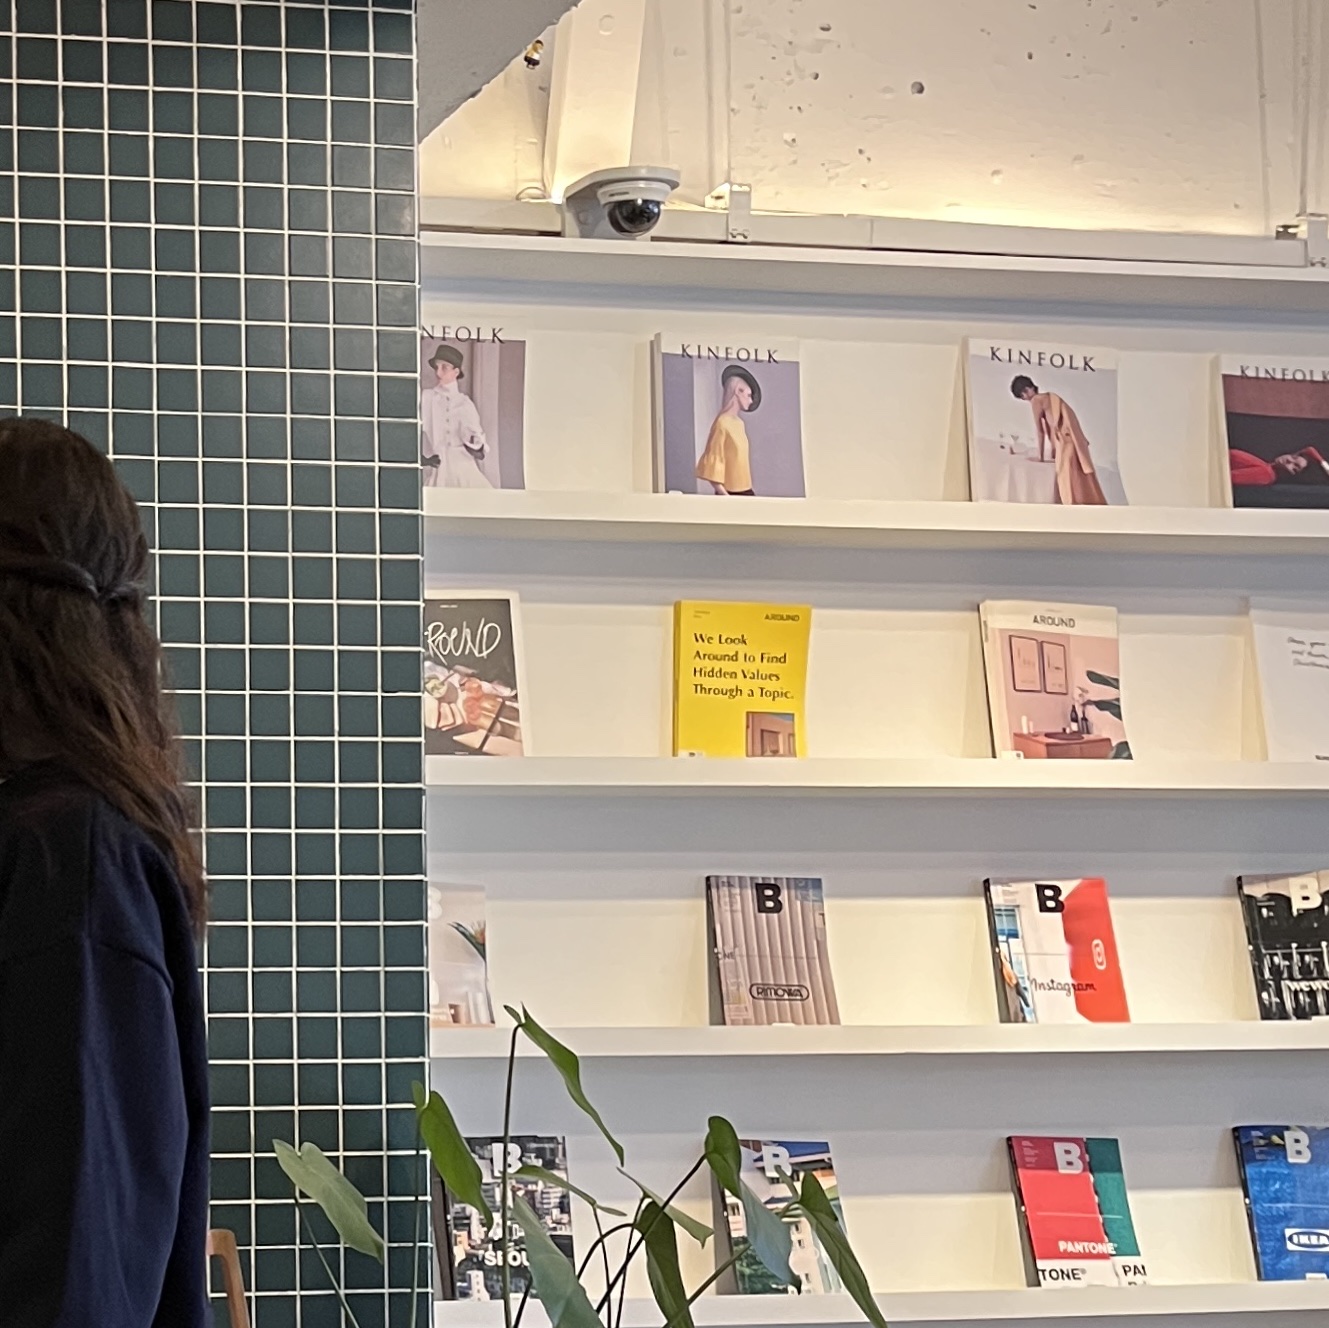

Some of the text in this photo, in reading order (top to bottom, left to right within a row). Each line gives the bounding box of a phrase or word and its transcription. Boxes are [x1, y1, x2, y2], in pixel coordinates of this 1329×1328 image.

[681, 343, 779, 364] KINFOLK
[990, 346, 1096, 372] KINFOLK
[764, 613, 800, 622] AROUND
[1033, 615, 1076, 628] AROUND
[694, 632, 748, 646] We Look
[693, 650, 787, 665] Around to Find
[693, 667, 781, 682] Hidden Values
[693, 683, 743, 699] Through
[747, 687, 755, 698] a
[755, 882, 783, 914] B
[1035, 883, 1066, 913] B
[1289, 877, 1323, 914] B
[756, 986, 804, 999] RIMOWA
[1029, 977, 1097, 997] Instagram
[1283, 1130, 1312, 1164] B
[1053, 1141, 1084, 1174] B
[1058, 1240, 1117, 1255] PANTONE
